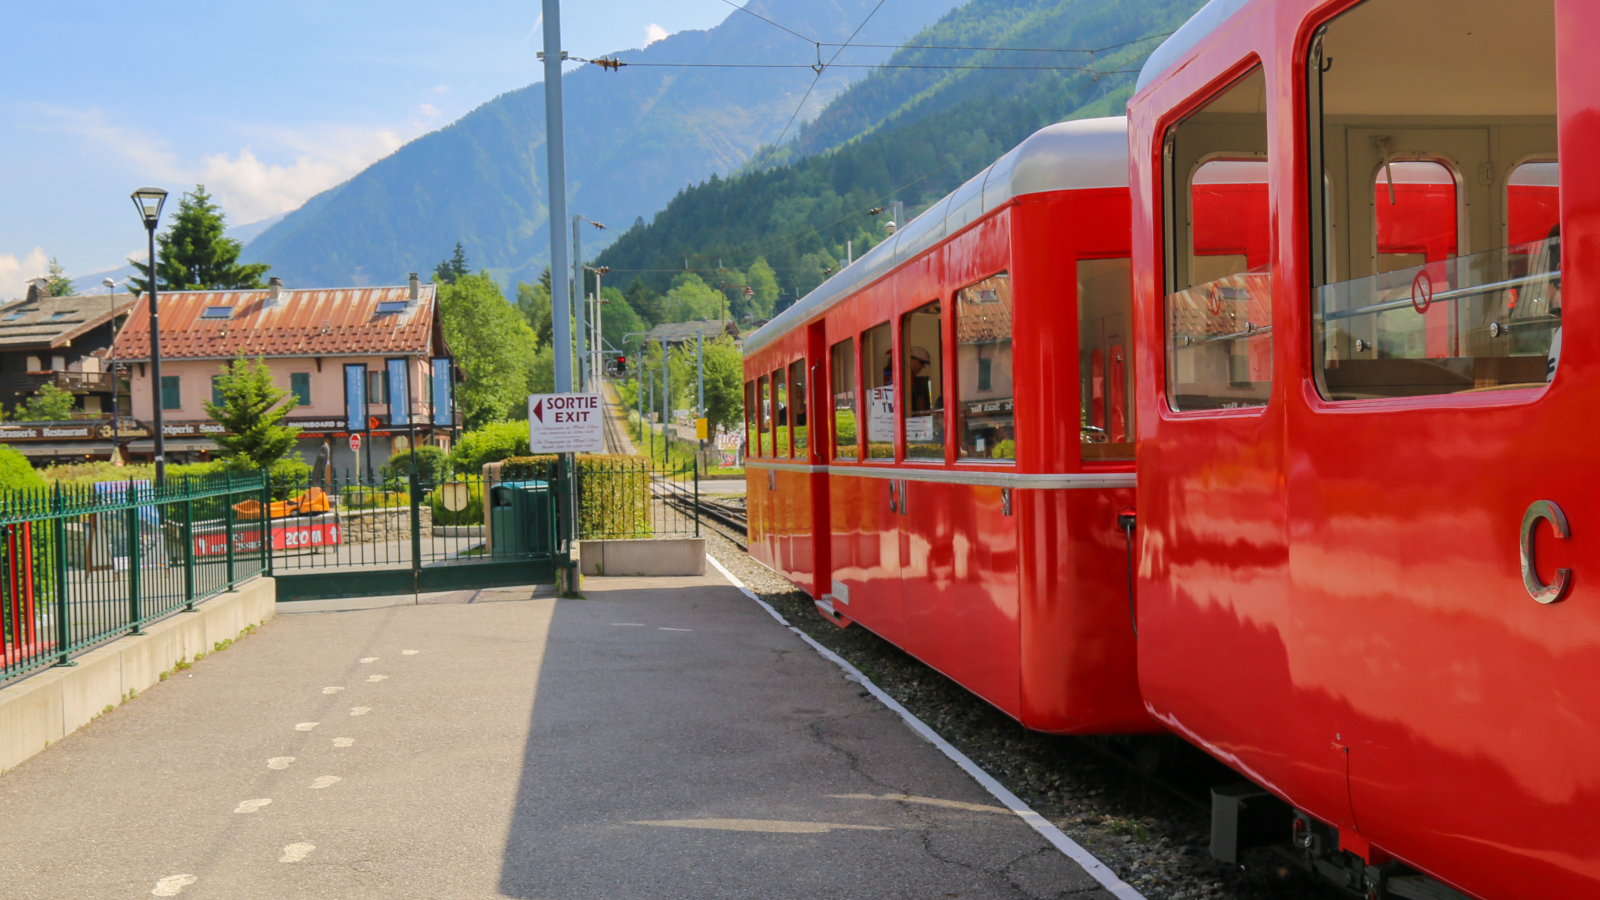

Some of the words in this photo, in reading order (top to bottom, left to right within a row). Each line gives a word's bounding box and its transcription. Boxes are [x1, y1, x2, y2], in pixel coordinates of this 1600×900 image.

[547, 396, 597, 409] SORTIE
[555, 412, 590, 422] EXIT
[0, 429, 37, 438] Brasserie
[43, 428, 88, 437] Restaurant
[199, 424, 226, 432] Snack
[286, 530, 309, 545] 200
[312, 530, 322, 543] M
[1520, 500, 1571, 604] C
